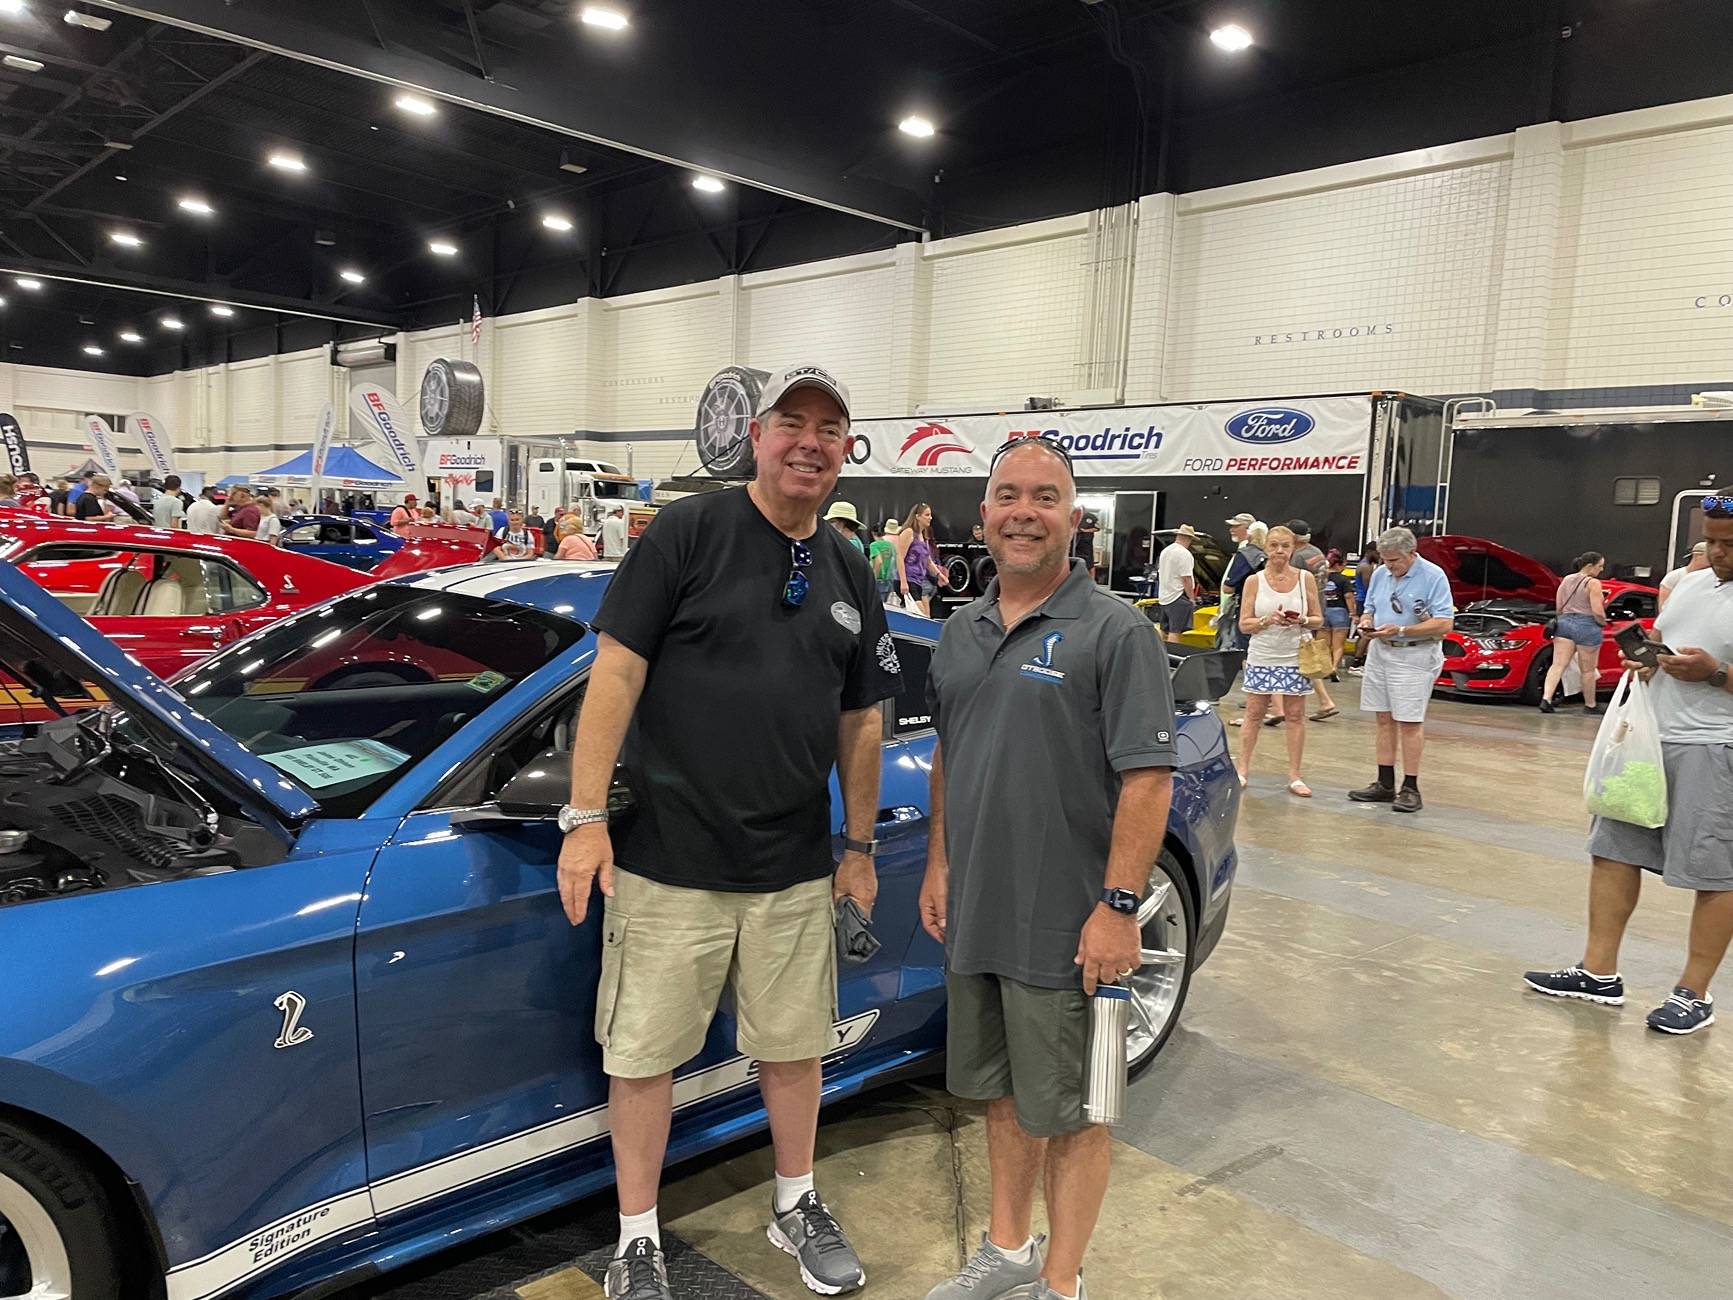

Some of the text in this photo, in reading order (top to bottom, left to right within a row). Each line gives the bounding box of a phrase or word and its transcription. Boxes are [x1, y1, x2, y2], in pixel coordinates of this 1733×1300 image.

[1254, 324, 1392, 345] RESTROOMS
[367, 392, 415, 472] BFGoodrich
[1241, 413, 1297, 439] Ford
[440, 454, 486, 465] BFGoodrich
[930, 466, 972, 474] MUSTANG
[1183, 455, 1360, 472] FORD PERFORMANCE
[899, 715, 931, 726] SHELBY
[249, 1207, 330, 1252] Signature
[252, 1227, 311, 1264] Edition
